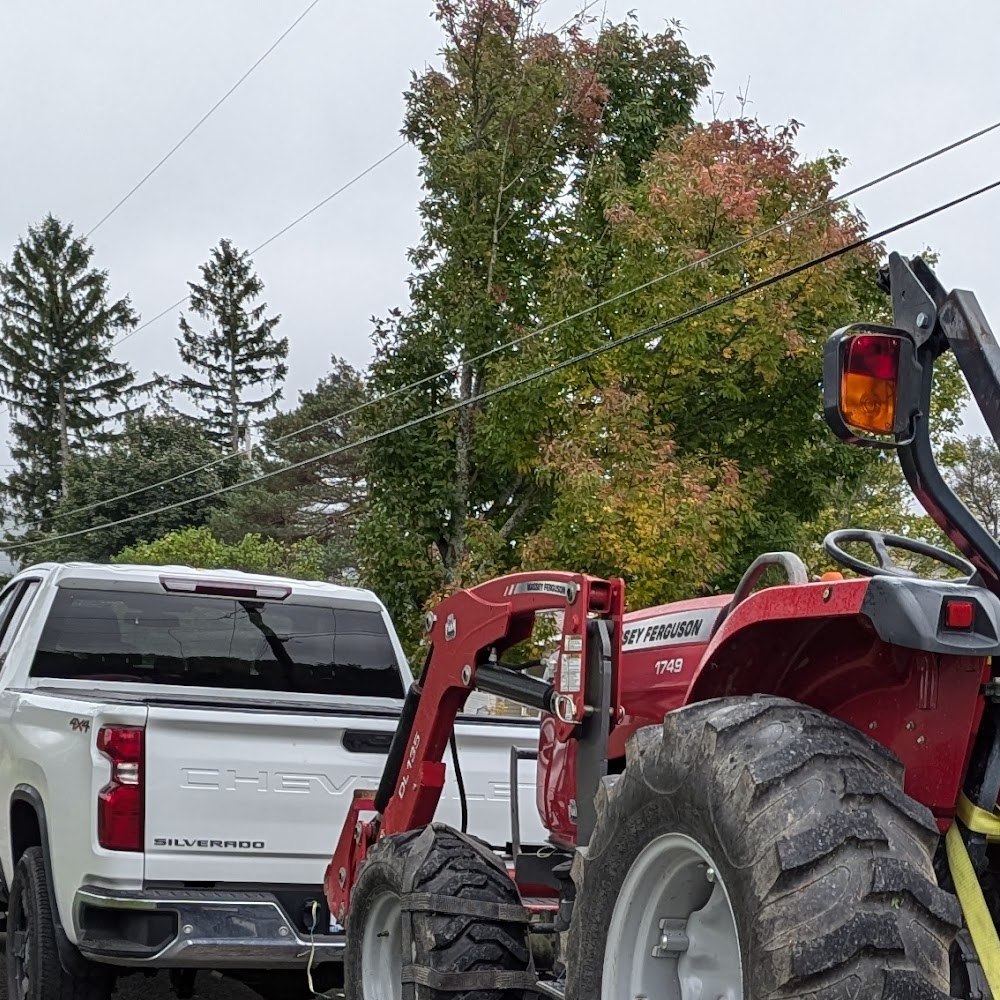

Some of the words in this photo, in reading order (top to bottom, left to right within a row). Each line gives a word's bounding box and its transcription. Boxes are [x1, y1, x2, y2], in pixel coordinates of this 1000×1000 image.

[643, 619, 703, 642] FERGUSON
[655, 658, 684, 675] 1749
[154, 838, 265, 849] SILVERADO
